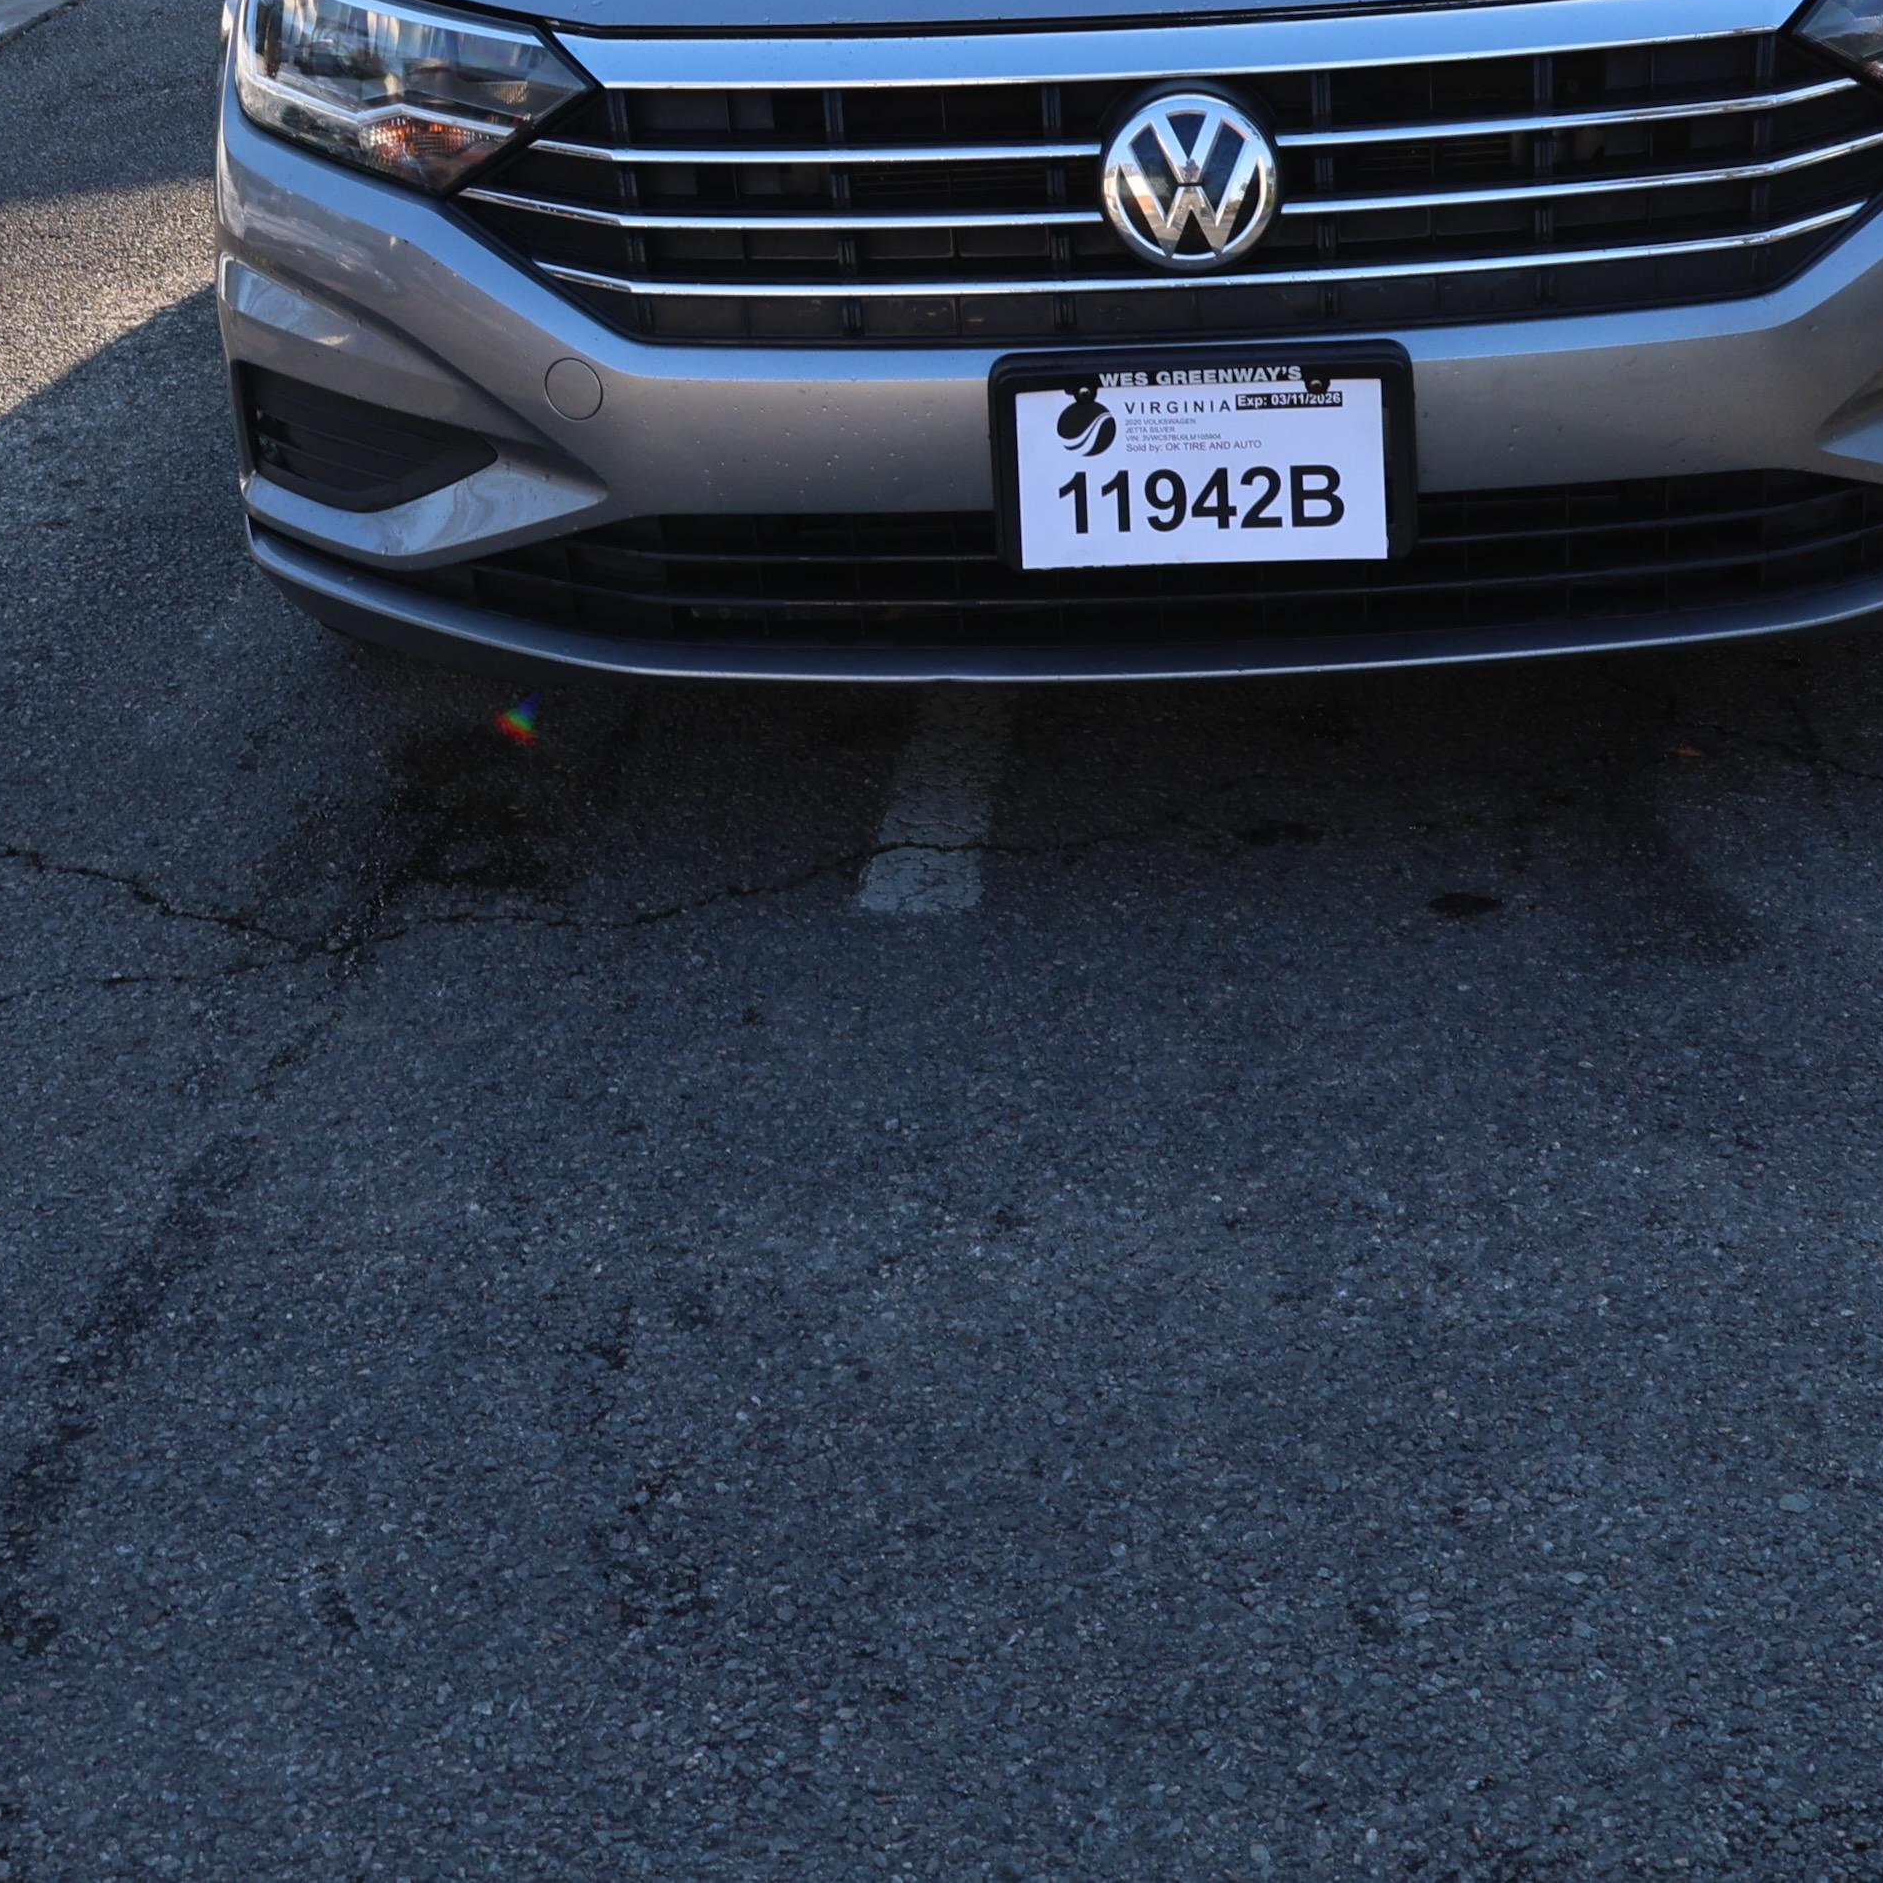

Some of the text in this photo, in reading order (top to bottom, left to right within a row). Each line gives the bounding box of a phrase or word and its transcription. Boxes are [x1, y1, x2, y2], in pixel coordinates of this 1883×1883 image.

[1099, 365, 1302, 388] WES GREENWAY'S
[1124, 399, 1232, 415] VIRGINIA
[1237, 392, 1341, 408] Exp: 03/11/2026
[1144, 417, 1196, 425] VOLKSWAGEN
[1125, 426, 1148, 434] JETTA
[1126, 440, 1262, 454] Sold by: OK TIRE AND AUTO
[1059, 464, 1345, 534] 11942B
